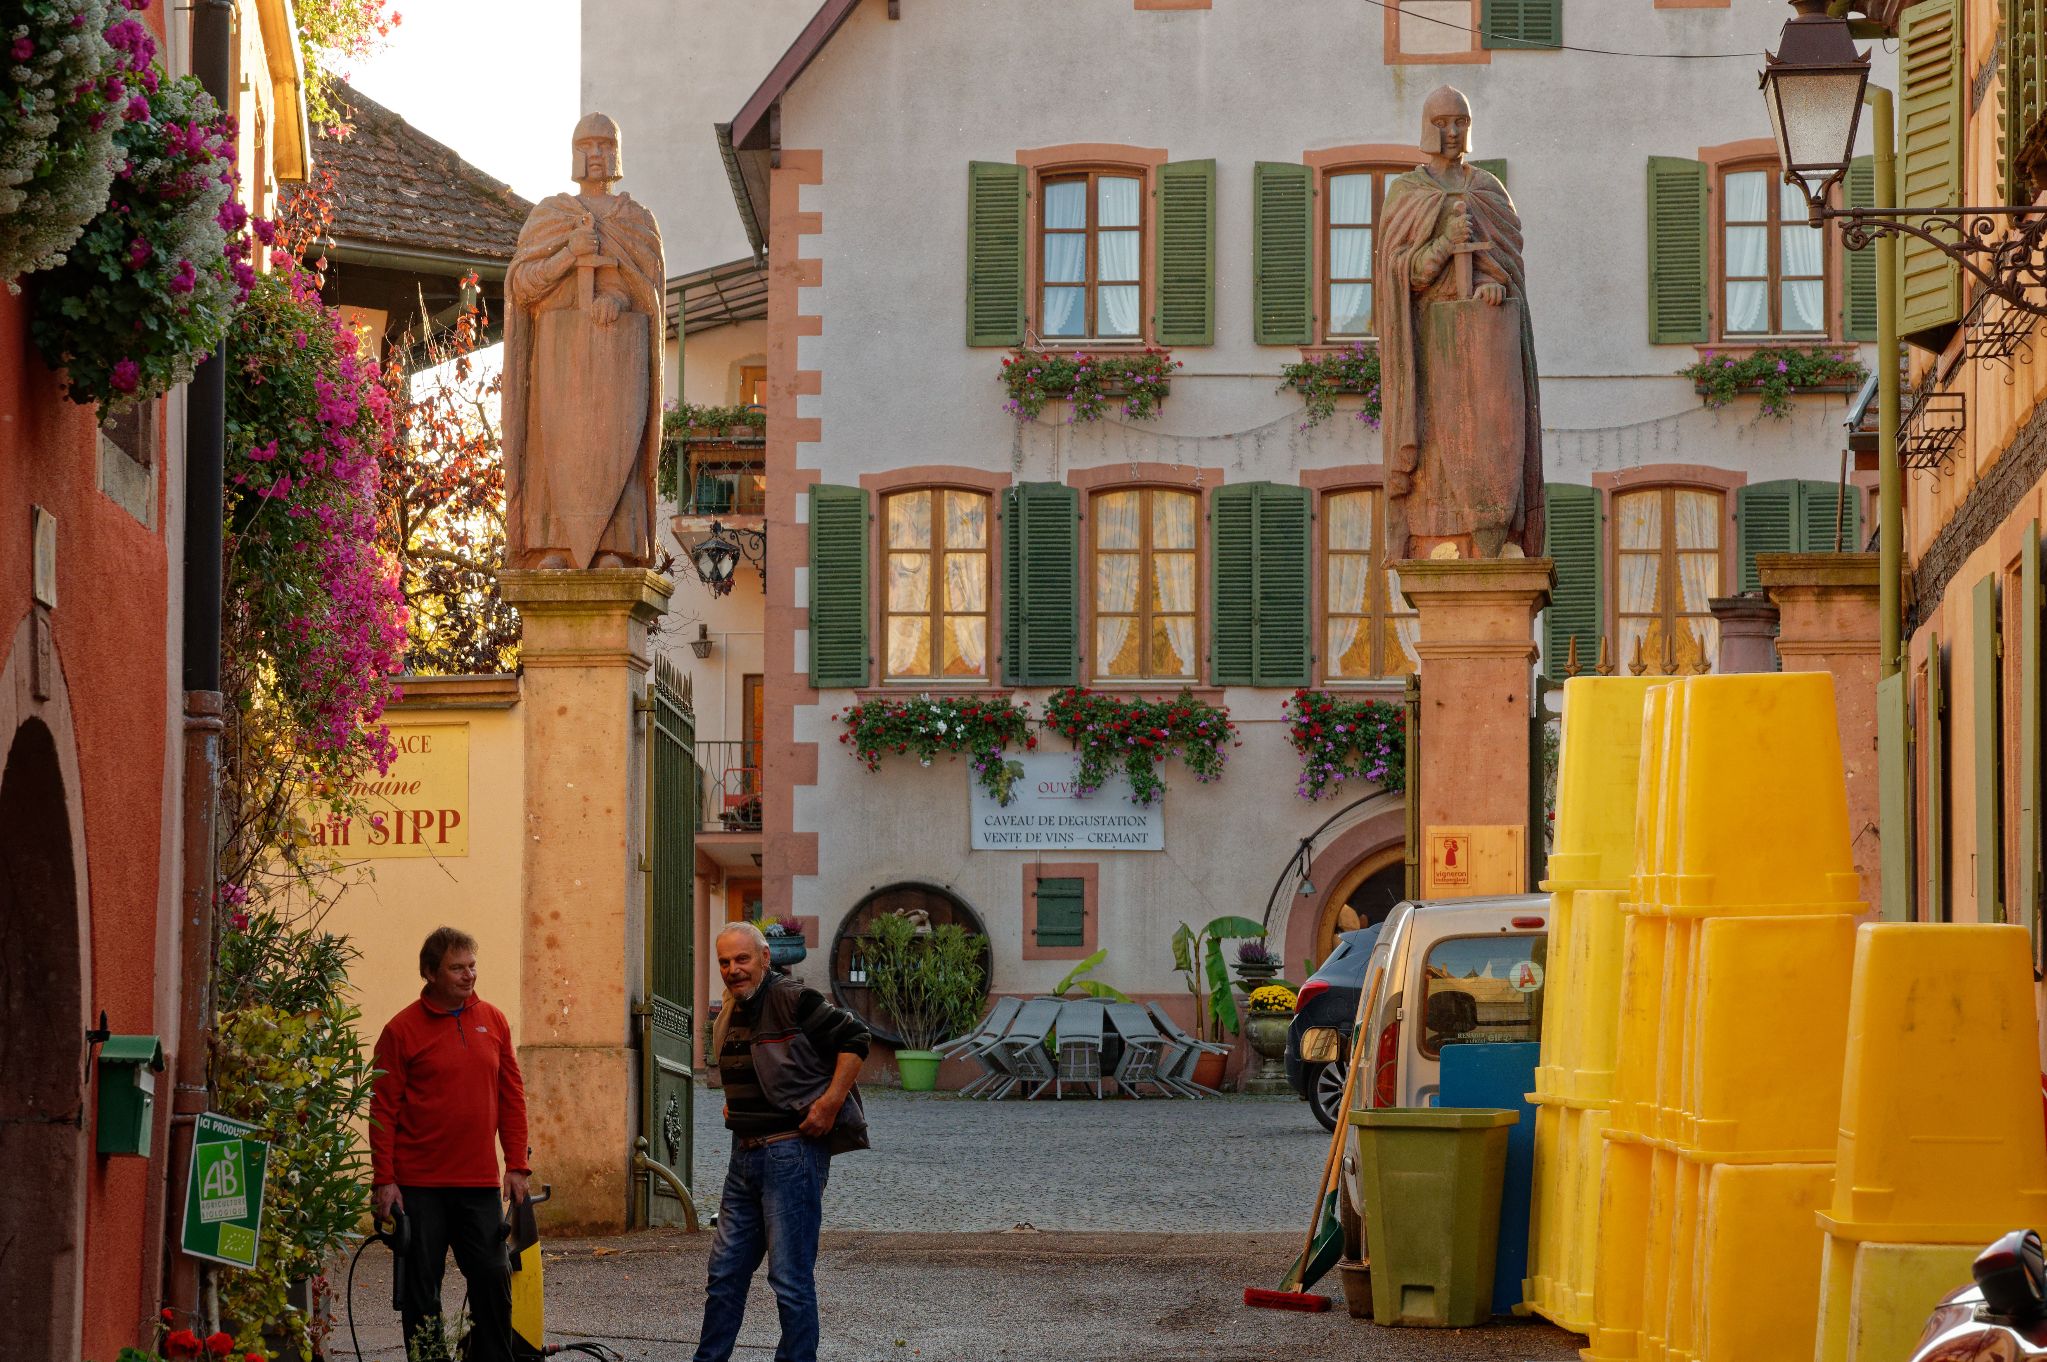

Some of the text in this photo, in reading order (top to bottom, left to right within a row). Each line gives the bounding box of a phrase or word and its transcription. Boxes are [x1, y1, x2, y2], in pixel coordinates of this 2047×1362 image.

[984, 815, 1147, 827] CAVEAU DE DEGUSTATION
[368, 809, 461, 846] SIPP
[983, 832, 1022, 843] VENTE
[1025, 832, 1042, 843] DE
[1045, 832, 1074, 843] VINS
[1087, 832, 1149, 843] CREMANT
[1435, 871, 1467, 880] vigneron
[1519, 963, 1537, 988] A
[199, 1117, 211, 1129] ICI
[203, 1160, 238, 1198] AB
[201, 1199, 246, 1210] AGRICULTURE
[201, 1207, 247, 1219] BIOLOGIQUE
